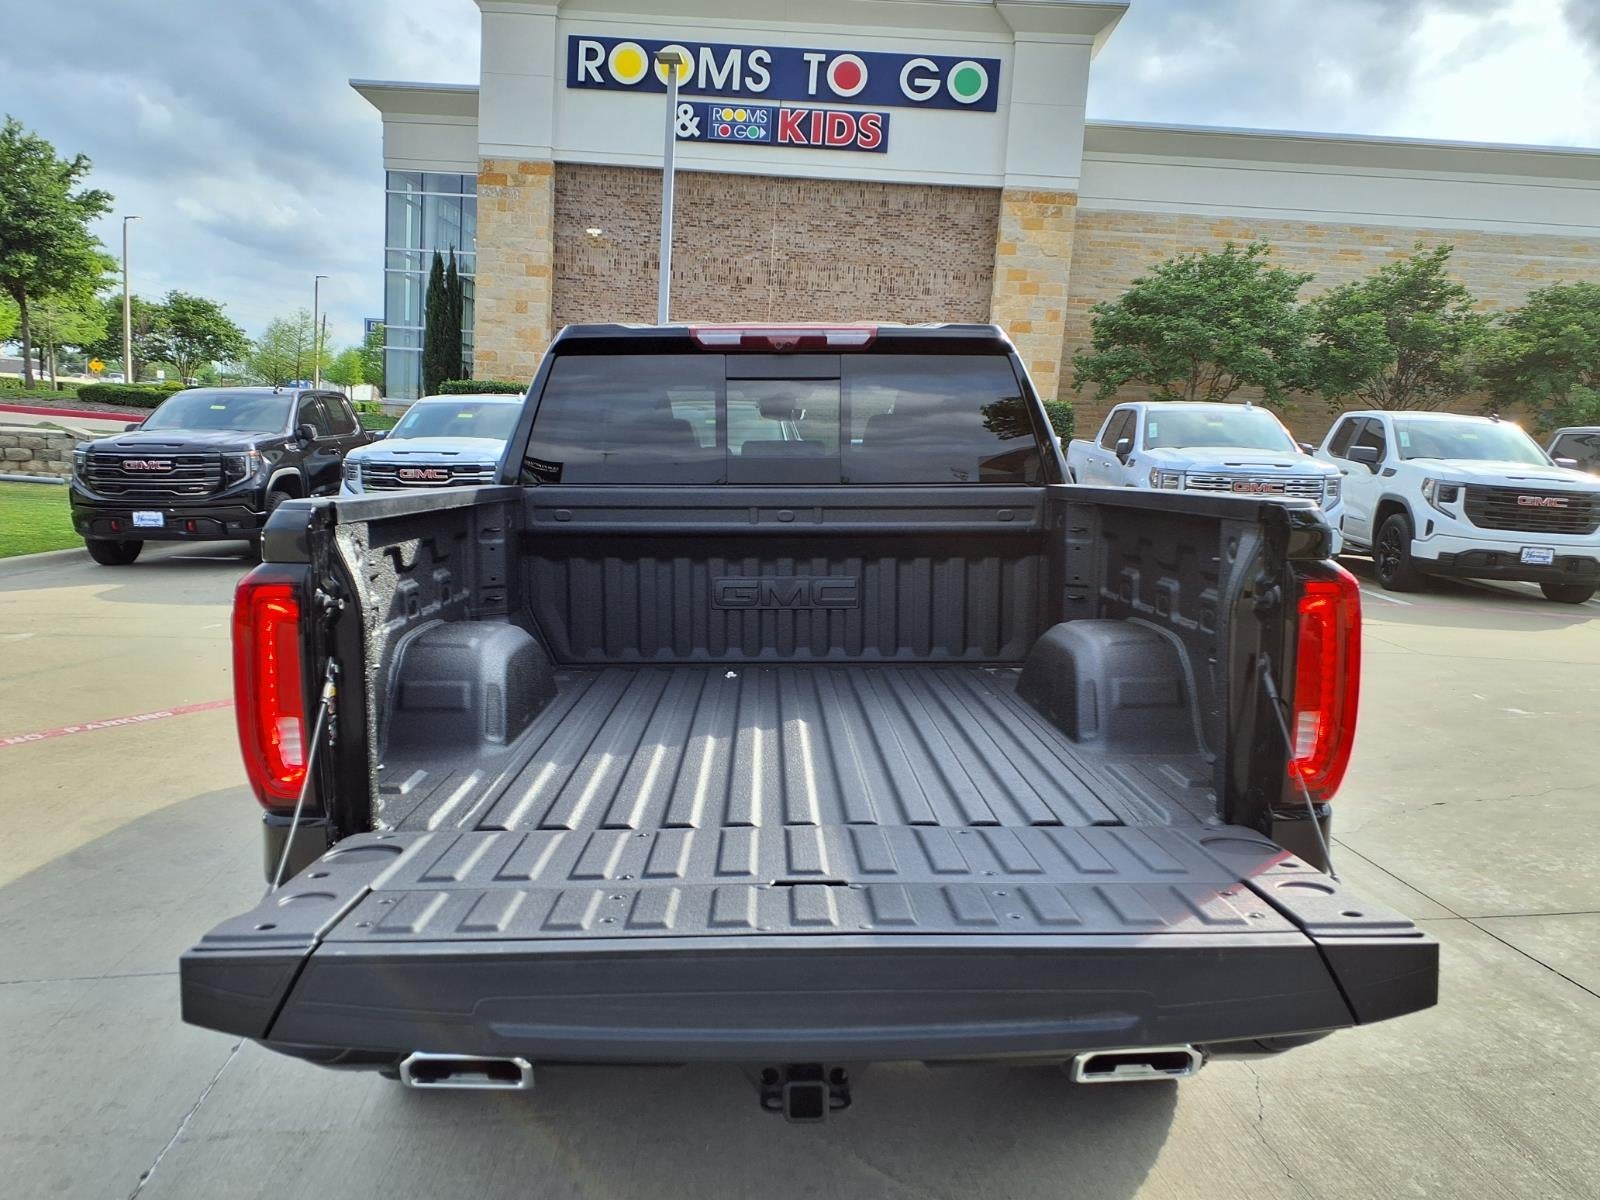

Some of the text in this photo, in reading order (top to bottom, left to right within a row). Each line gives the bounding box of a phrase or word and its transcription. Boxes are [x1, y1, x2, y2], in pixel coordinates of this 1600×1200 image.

[577, 40, 989, 105] ROOMS TO GO
[675, 103, 701, 138] &
[712, 107, 768, 125] ROOMS
[712, 123, 760, 139] TO GO
[777, 109, 883, 150] KIDS
[122, 459, 172, 471] GMC
[399, 468, 449, 480] GMC
[1233, 480, 1285, 494] GMC
[1517, 495, 1569, 509] GMC
[714, 579, 858, 608] GMC
